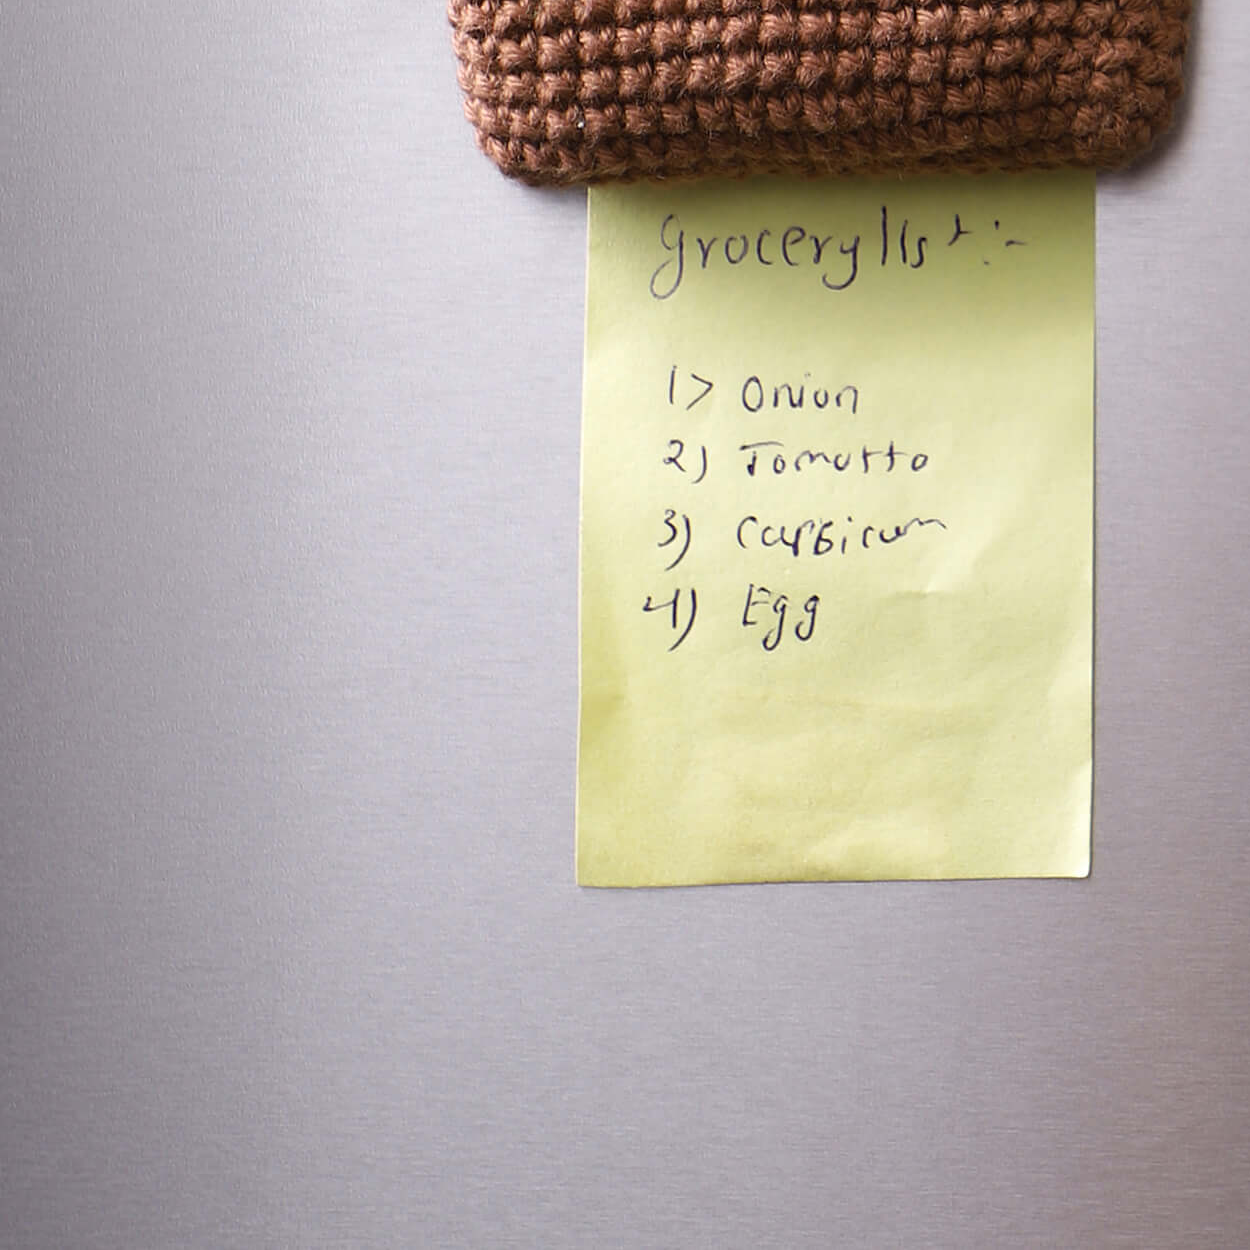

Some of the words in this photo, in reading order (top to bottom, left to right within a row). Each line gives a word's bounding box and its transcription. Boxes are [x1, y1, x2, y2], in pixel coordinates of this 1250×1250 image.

[741, 372, 859, 415] Onion
[662, 438, 708, 485] 2)
[657, 508, 692, 572] 3)
[641, 587, 698, 653] 4)
[741, 582, 821, 652] Egg
